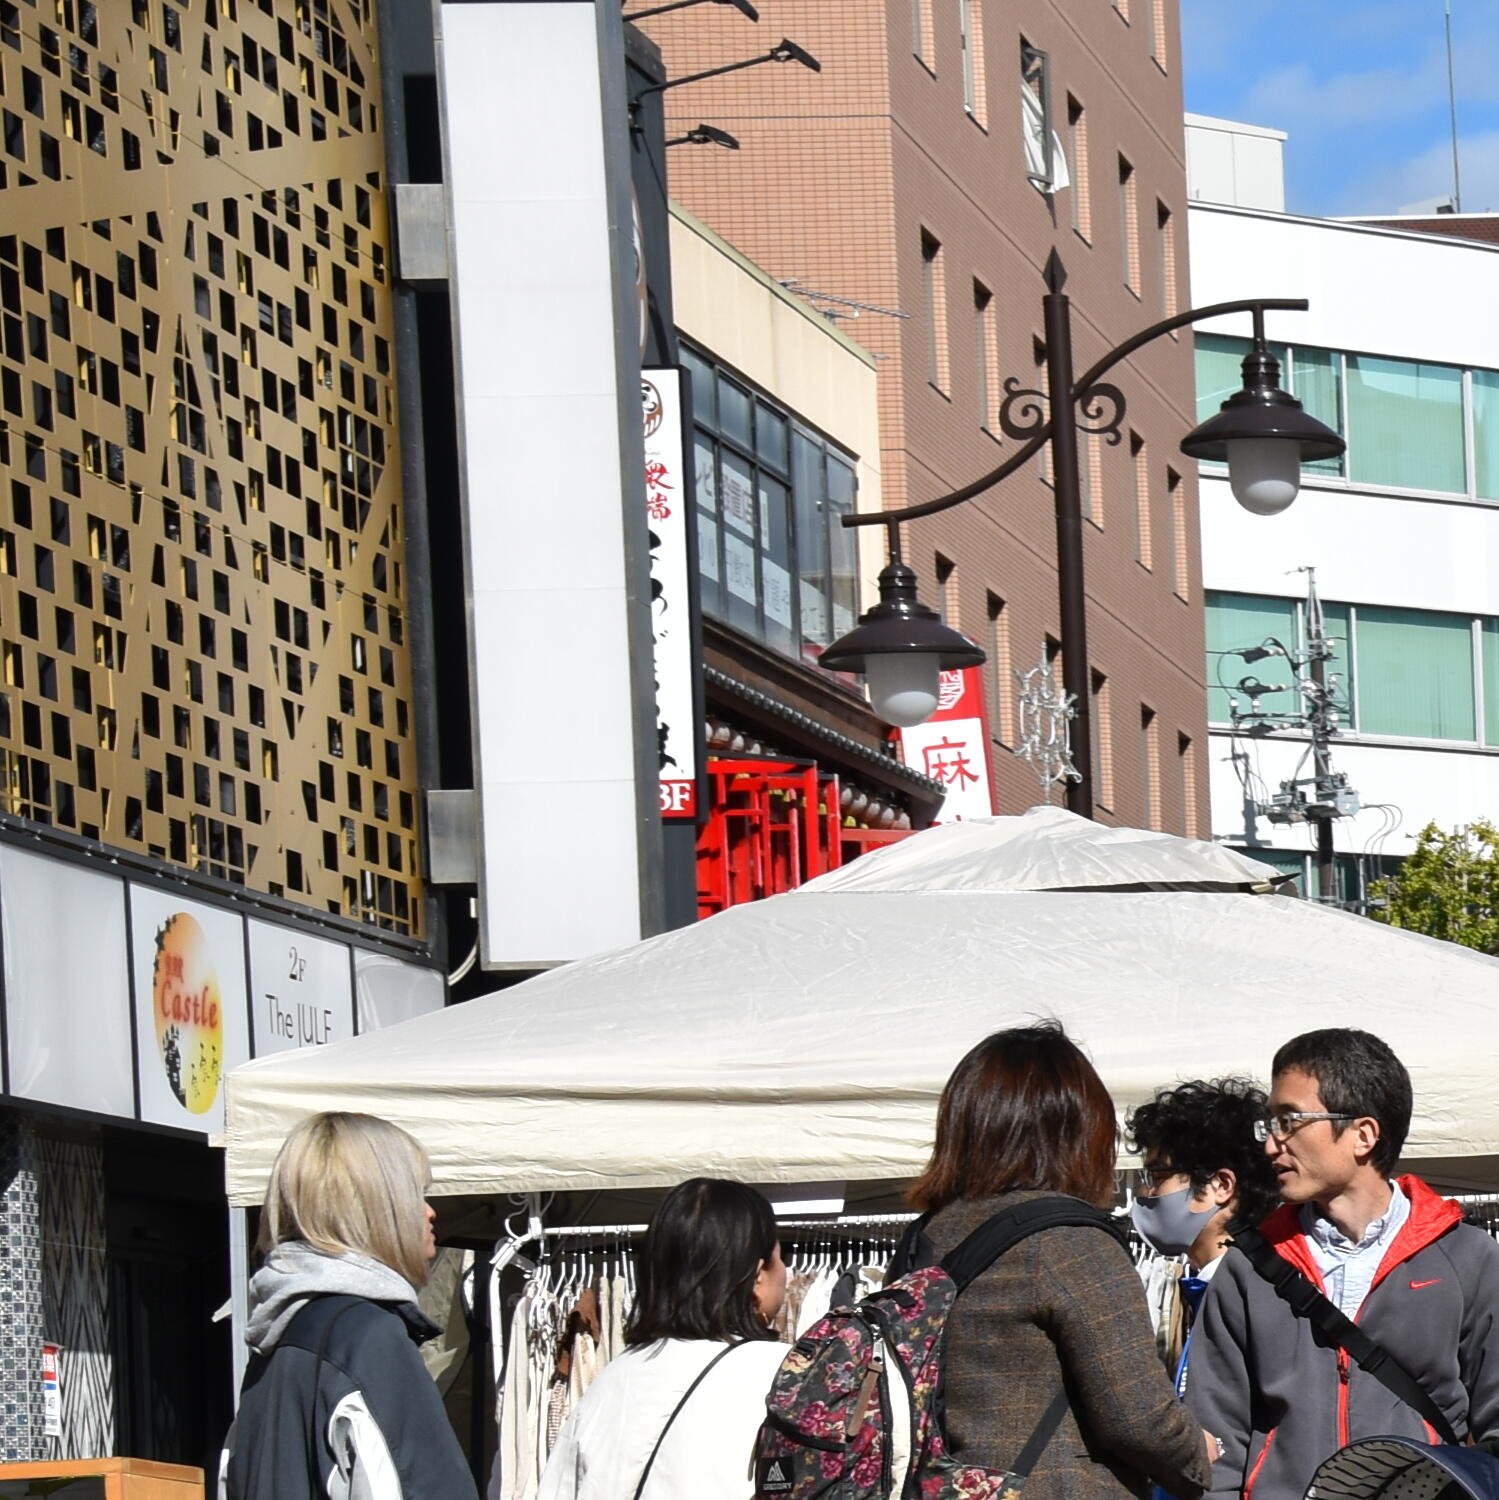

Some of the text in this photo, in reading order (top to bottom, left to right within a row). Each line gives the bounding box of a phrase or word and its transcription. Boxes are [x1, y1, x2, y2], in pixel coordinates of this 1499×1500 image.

[922, 735, 980, 793] 麻
[289, 946, 306, 982] 2F
[161, 980, 218, 1030] Castle
[265, 993, 294, 1040] The
